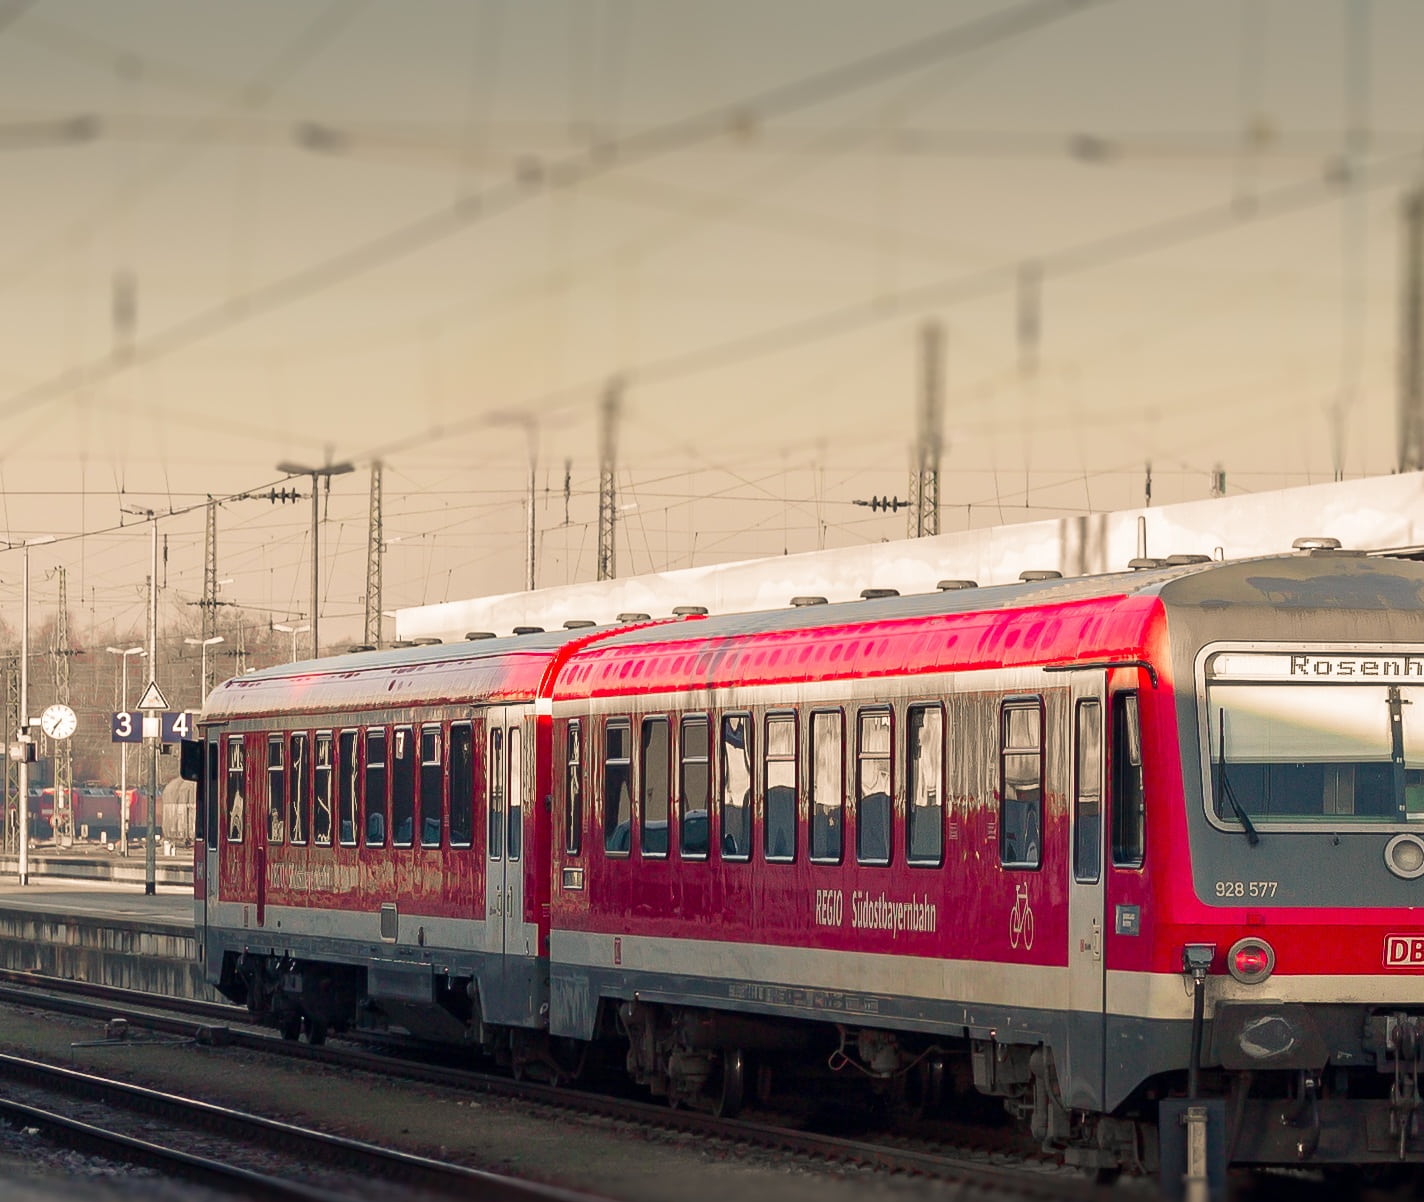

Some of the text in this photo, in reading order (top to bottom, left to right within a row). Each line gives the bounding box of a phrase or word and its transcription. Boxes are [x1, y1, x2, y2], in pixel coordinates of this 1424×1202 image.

[115, 712, 132, 737] 3
[172, 712, 189, 737] 4
[1215, 881, 1278, 898] 928 577
[815, 889, 936, 939] REGIO Südostbayernbahn
